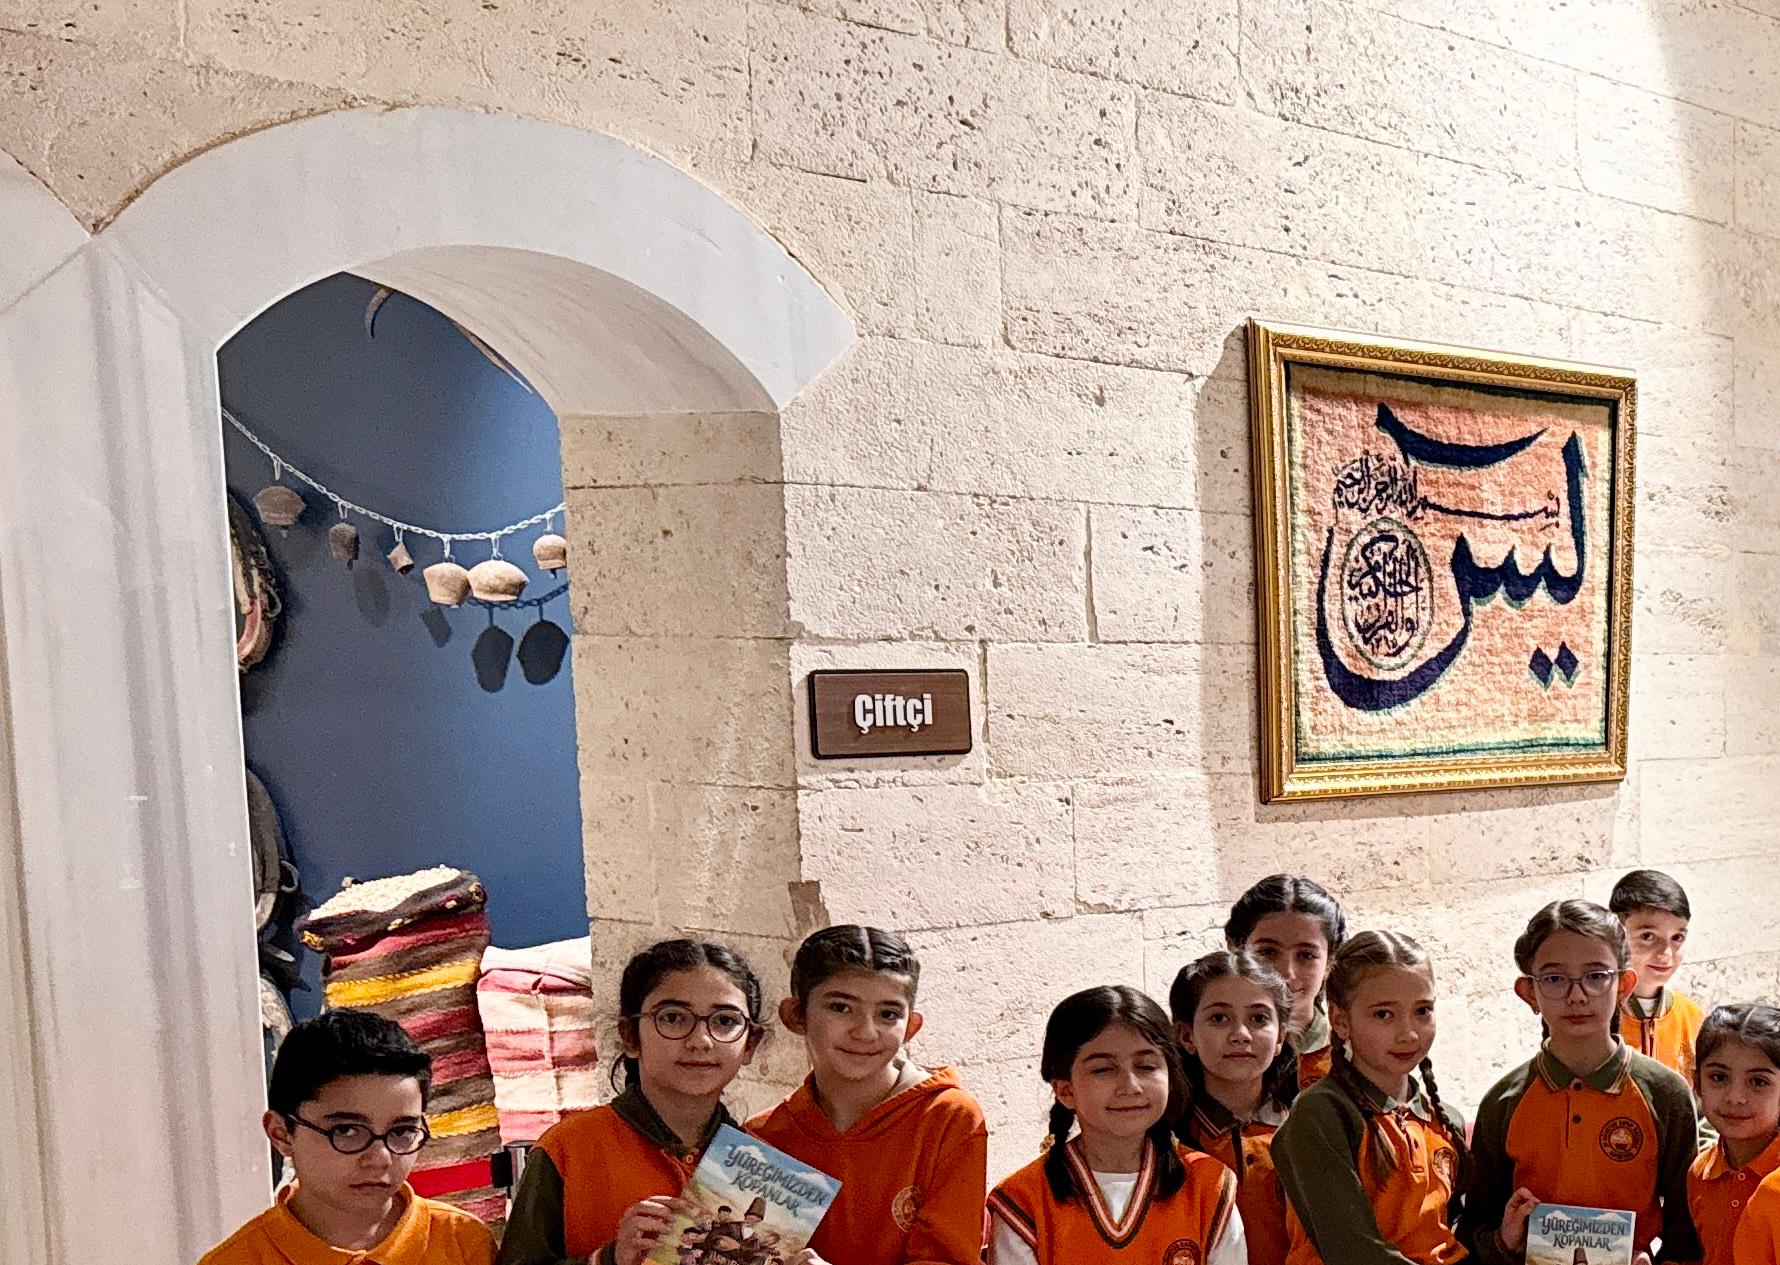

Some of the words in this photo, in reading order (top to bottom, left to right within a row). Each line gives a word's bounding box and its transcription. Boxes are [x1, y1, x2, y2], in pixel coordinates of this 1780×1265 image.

[854, 693, 933, 734] Çiftçi
[1541, 1216, 1625, 1236] YÜREĞİMİZDEN
[1553, 1234, 1612, 1251] KOPANLAR
